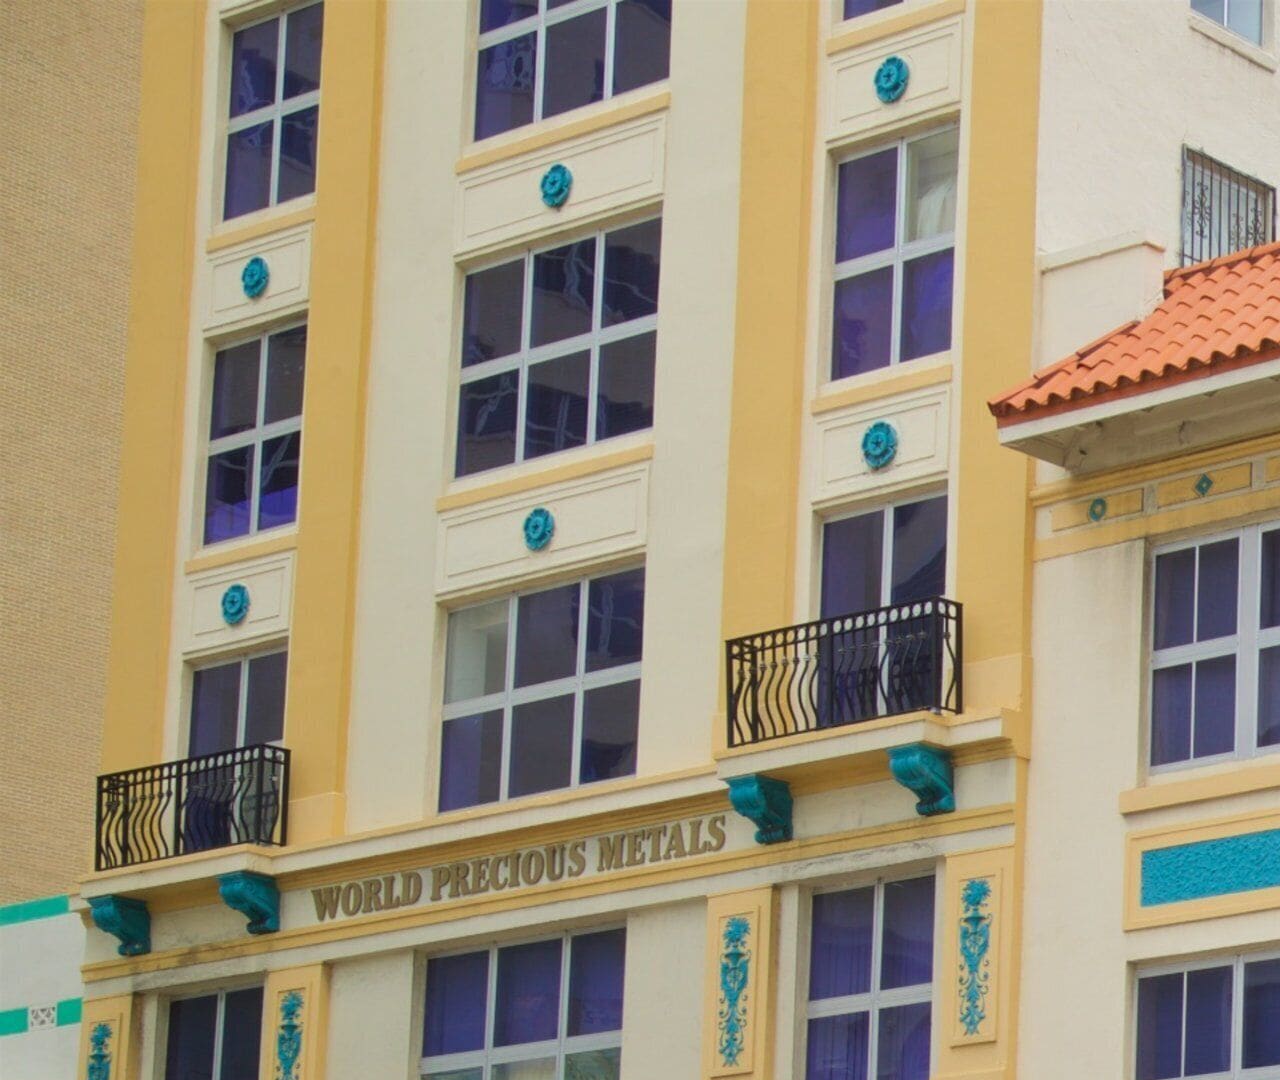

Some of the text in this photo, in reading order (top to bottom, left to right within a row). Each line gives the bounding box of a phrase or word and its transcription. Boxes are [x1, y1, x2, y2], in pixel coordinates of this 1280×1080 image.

[311, 815, 726, 922] WORLD PRECIOUS METALS
